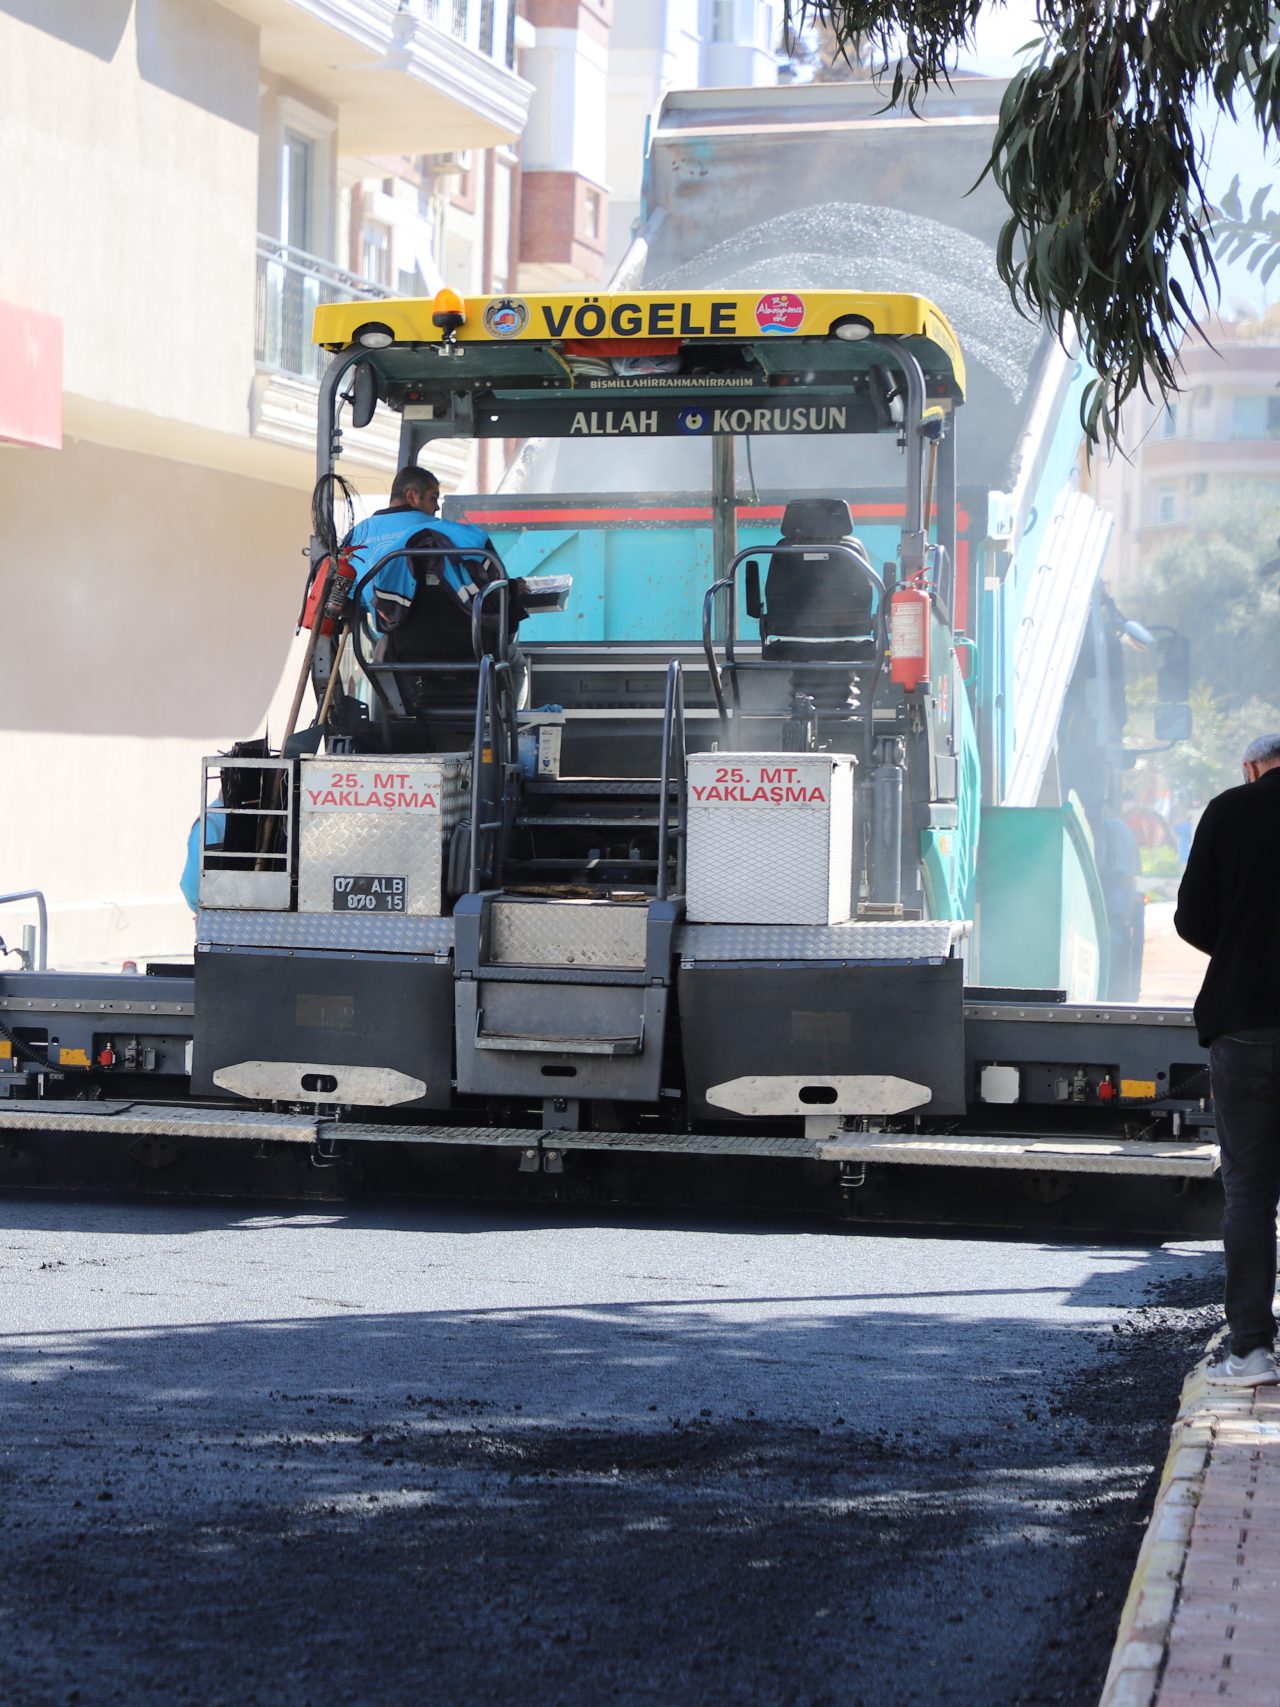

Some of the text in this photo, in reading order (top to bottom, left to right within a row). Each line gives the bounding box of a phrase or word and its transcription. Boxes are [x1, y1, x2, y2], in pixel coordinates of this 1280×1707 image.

[541, 297, 737, 337] VÖGELE
[590, 376, 753, 389] BİSMİLLAHİRRAHMANİRRAHİM
[570, 406, 846, 434] ALLAH KORUSUN
[331, 773, 413, 790] 25. MT.
[715, 768, 801, 784] 25. MT.
[308, 790, 437, 811] YAKLAŞMA
[692, 786, 826, 806] YAKLAŞMA
[335, 878, 403, 893] 07 ALB
[386, 895, 403, 909] 15
